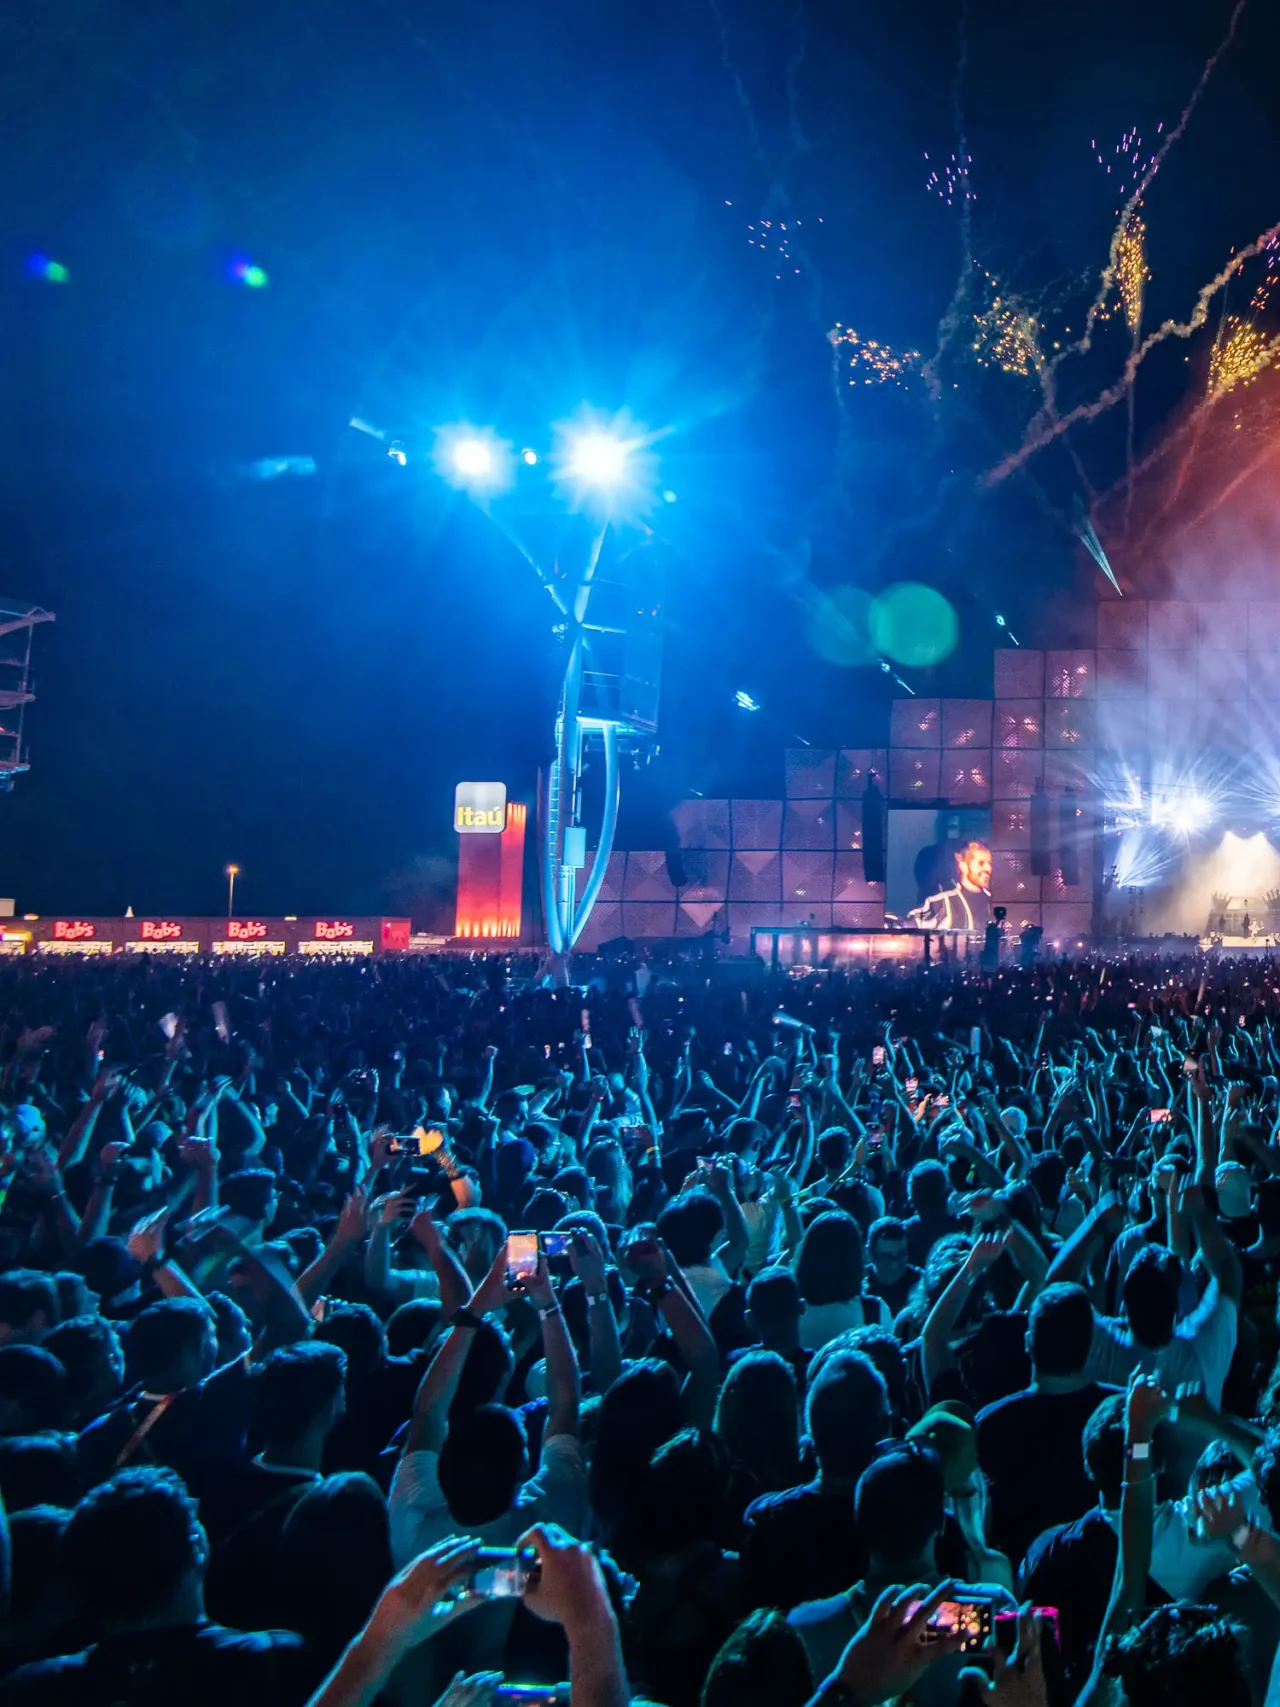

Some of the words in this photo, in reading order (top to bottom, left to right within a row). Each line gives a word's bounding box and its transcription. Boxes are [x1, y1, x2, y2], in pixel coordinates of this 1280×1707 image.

[456, 805, 503, 826] Itaú
[54, 921, 95, 939] Bob's
[141, 921, 182, 939] Bob's
[228, 921, 267, 939] Bob's
[315, 921, 354, 939] Bob's
